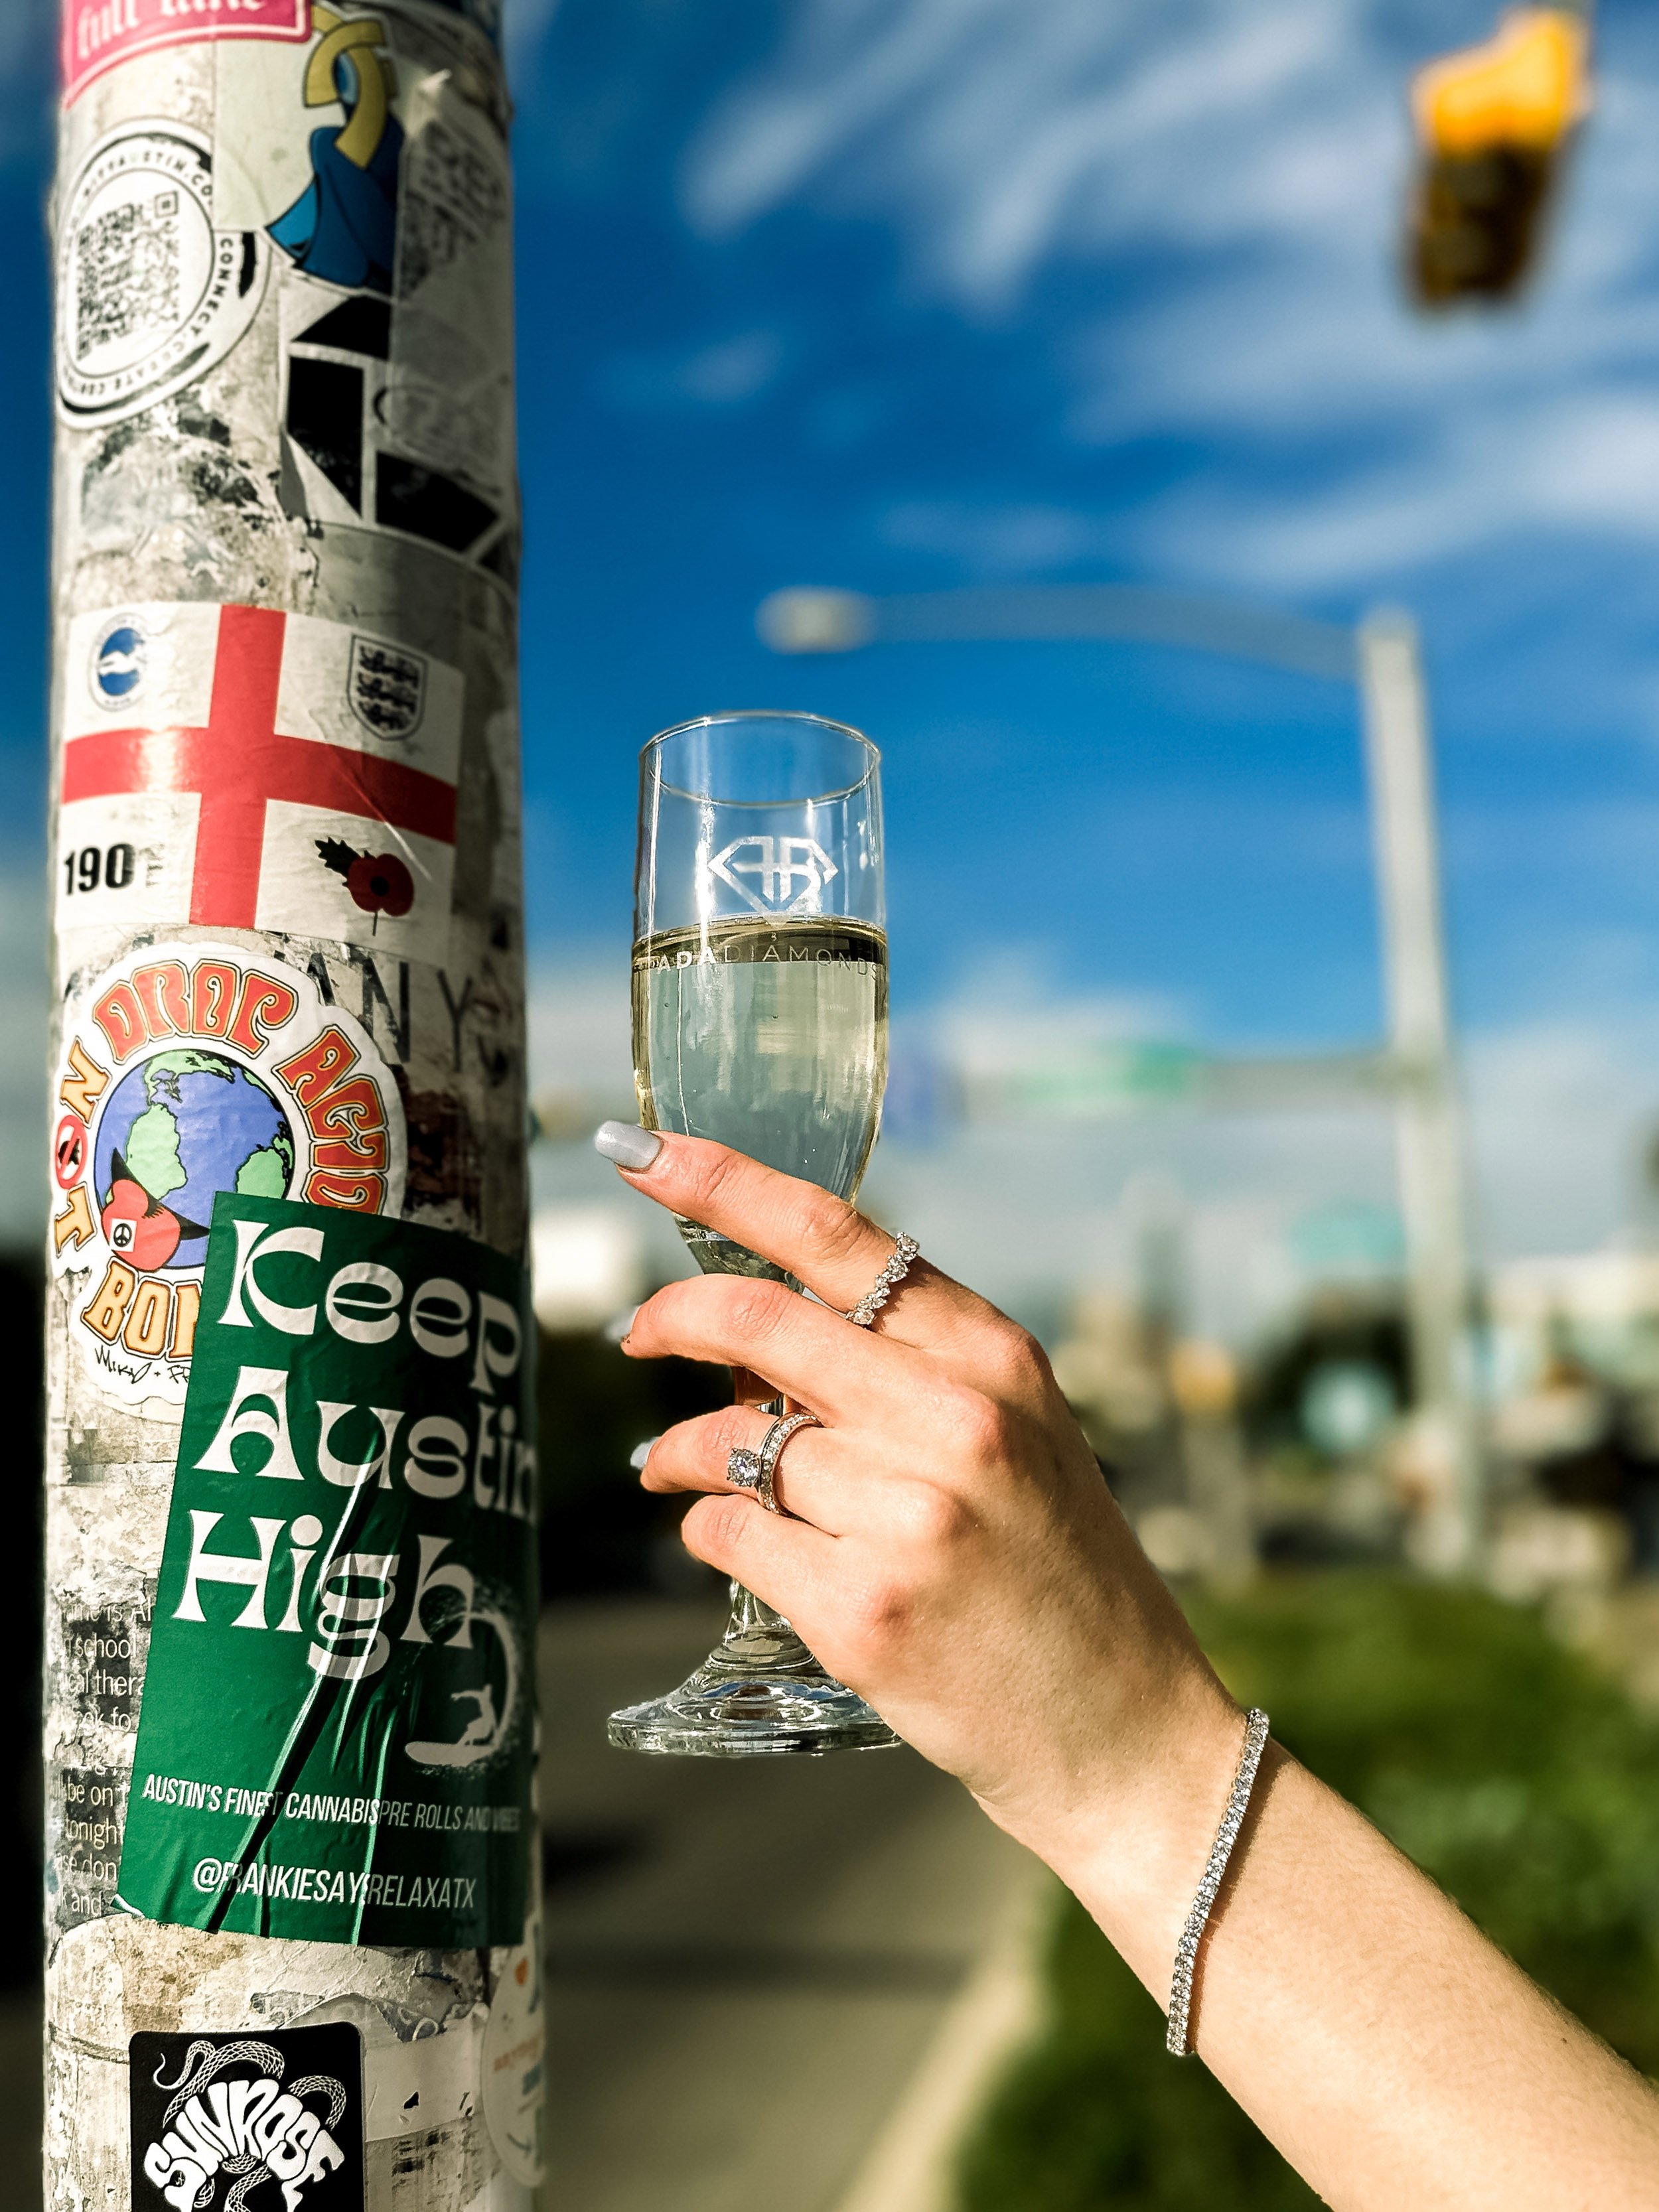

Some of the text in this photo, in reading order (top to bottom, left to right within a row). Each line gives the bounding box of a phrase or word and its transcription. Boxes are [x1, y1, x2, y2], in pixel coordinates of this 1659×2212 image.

[93, 958, 299, 1066] DROP
[217, 1219, 522, 1394] Keep
[192, 1365, 537, 1524] Austin
[171, 1509, 475, 1680] High
[90, 1785, 113, 1807] on
[141, 1773, 223, 1812] AUSTIN'S
[284, 1792, 380, 1826] CANNABIS
[378, 1800, 413, 1827] PRE
[414, 1803, 463, 1830] ROLLS
